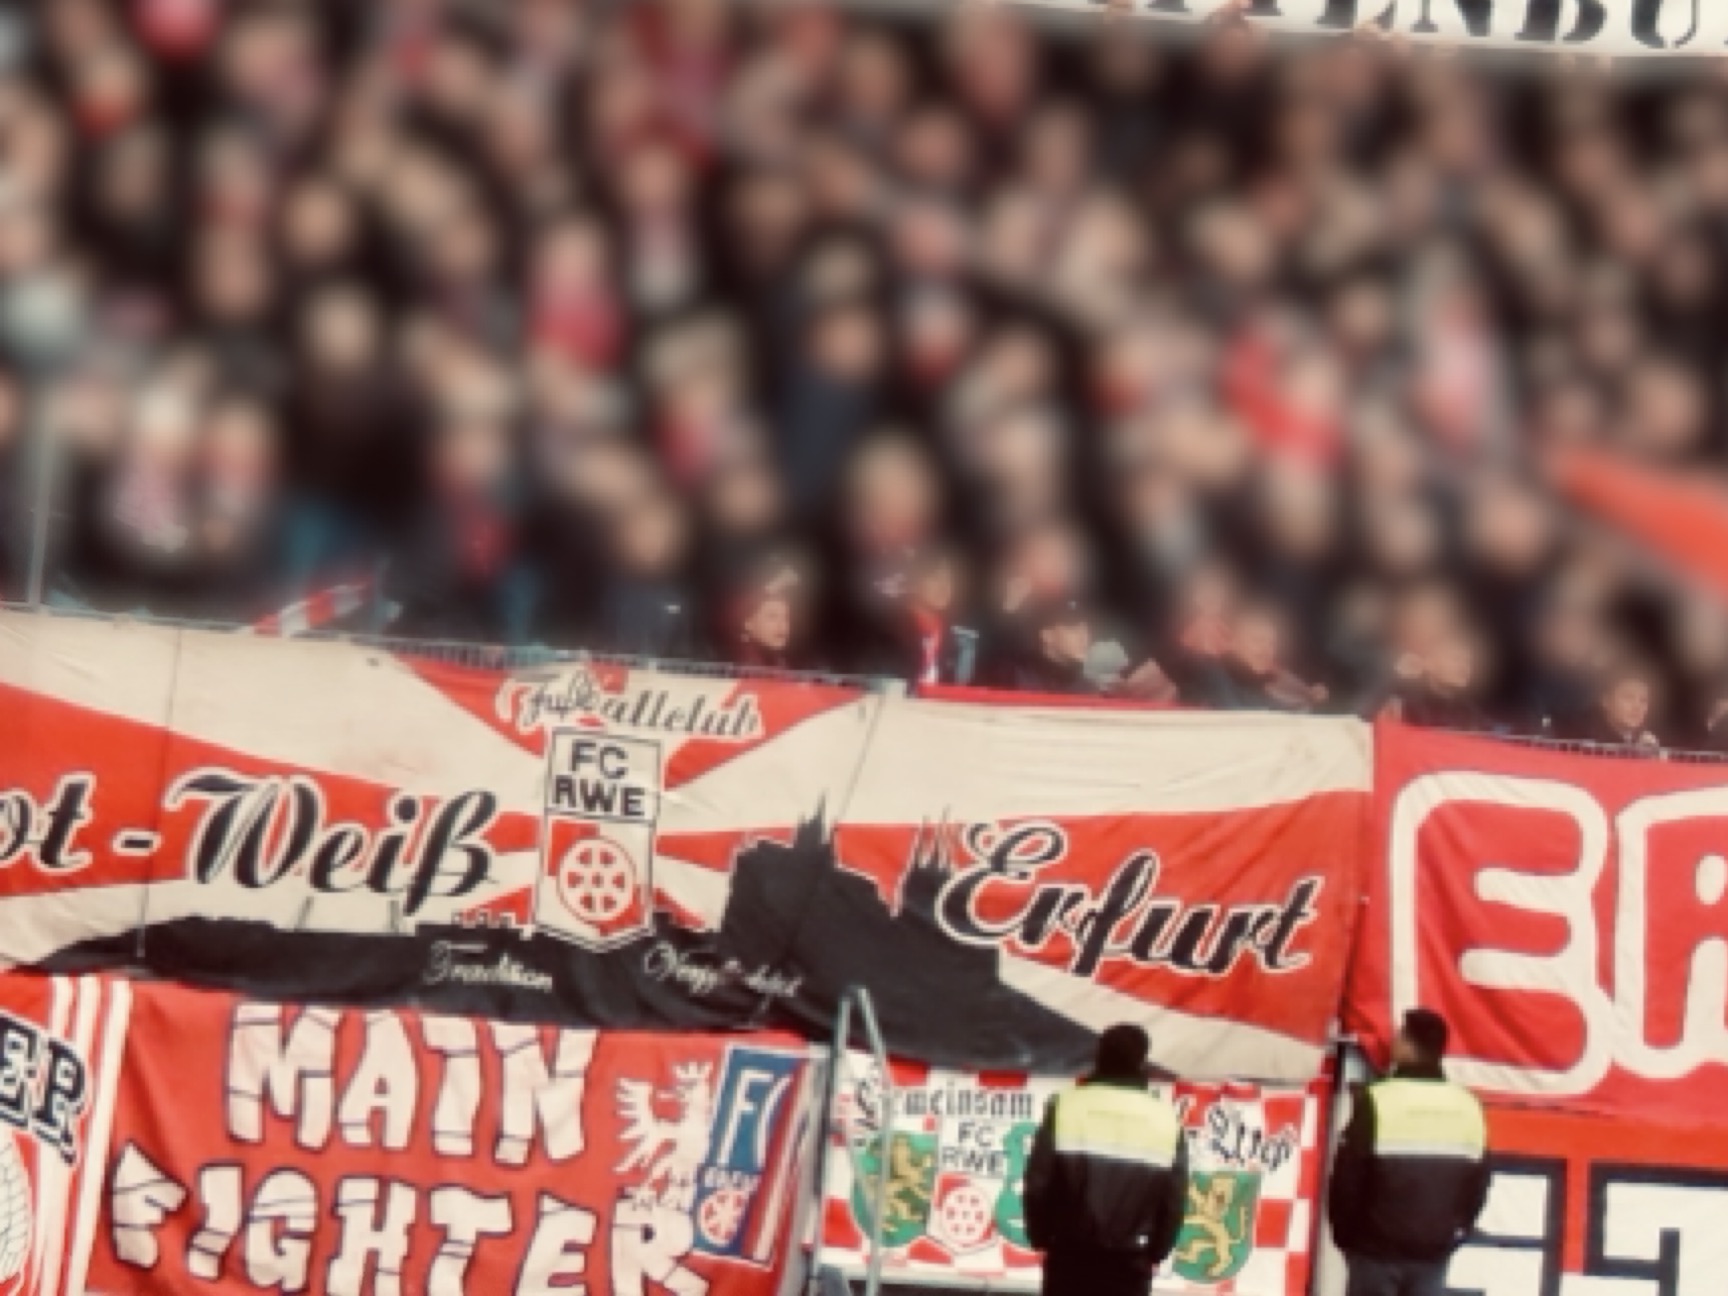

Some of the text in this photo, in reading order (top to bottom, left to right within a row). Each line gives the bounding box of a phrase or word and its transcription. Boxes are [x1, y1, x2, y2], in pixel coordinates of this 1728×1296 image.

[570, 739, 629, 780] FC
[552, 774, 646, 817] RWE
[936, 820, 1323, 979] Erfurt
